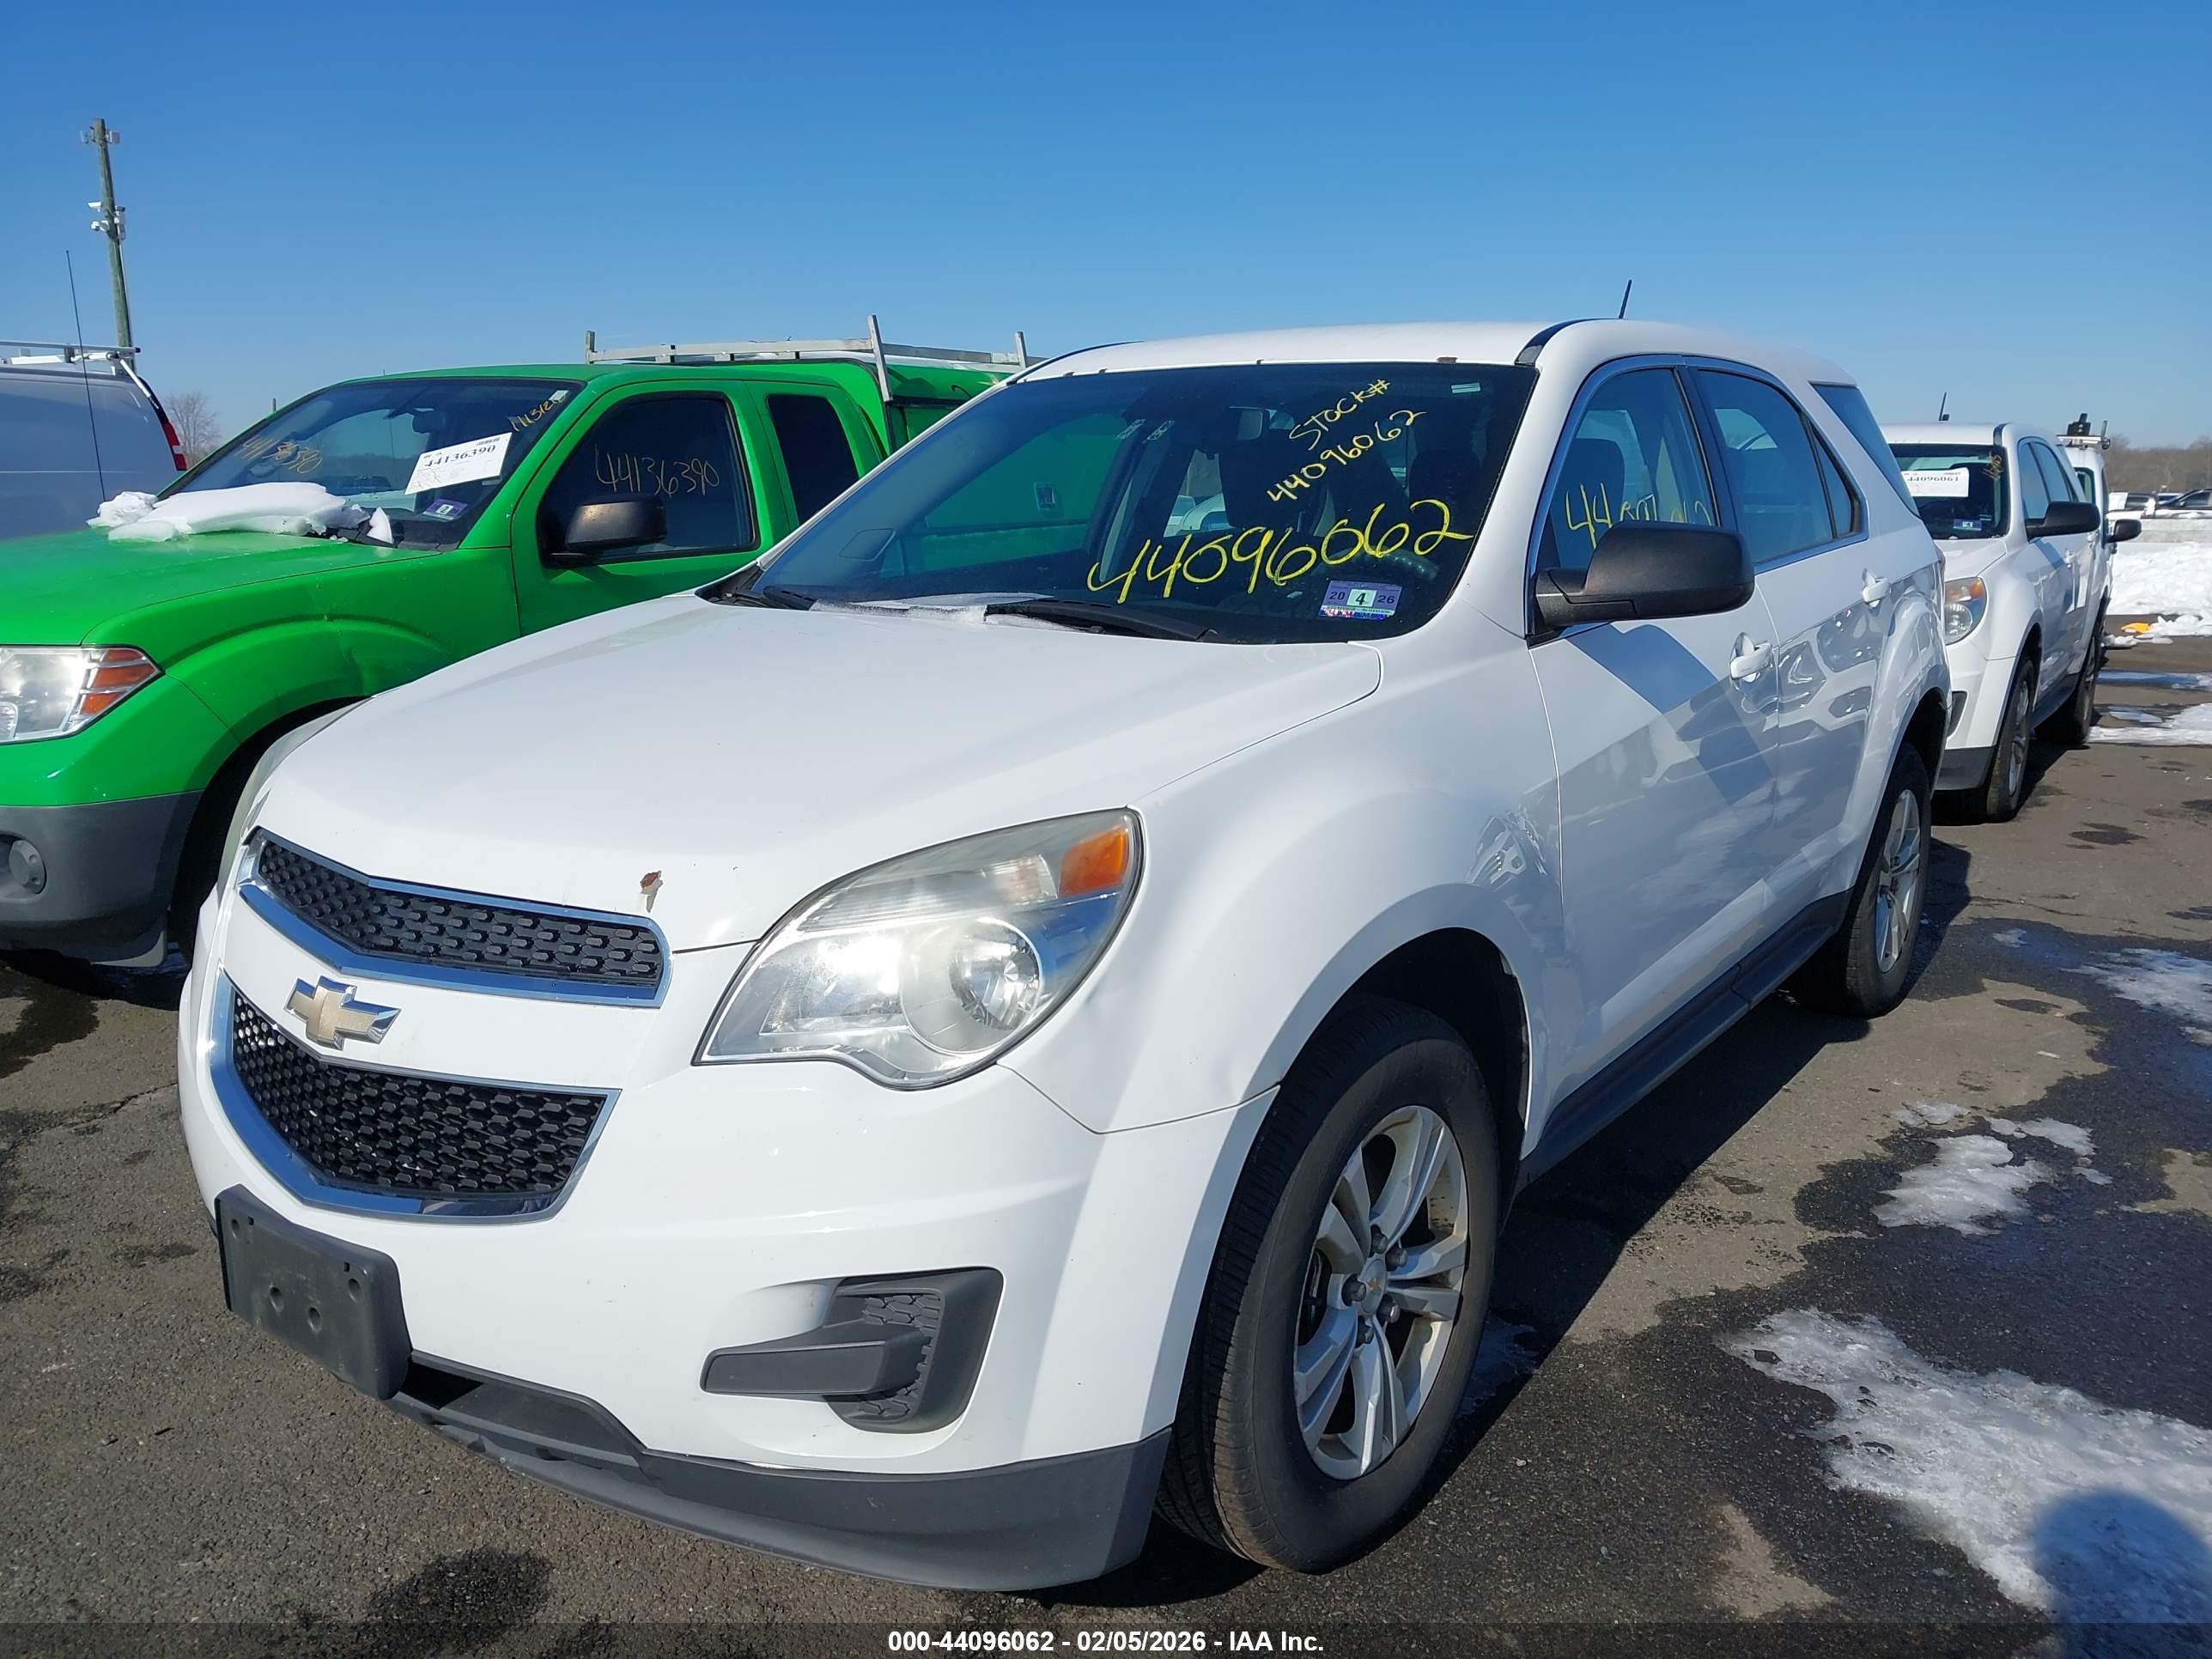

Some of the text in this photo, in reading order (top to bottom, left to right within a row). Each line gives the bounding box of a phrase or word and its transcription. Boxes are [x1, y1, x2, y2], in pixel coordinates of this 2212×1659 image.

[1289, 379, 1390, 451] STOCK#
[424, 444, 496, 467] 44136390
[594, 444, 720, 498] 44136390
[1267, 410, 1427, 501] 44096062
[1087, 499, 1473, 604] 44096062
[1329, 591, 1395, 605] 20 4 26
